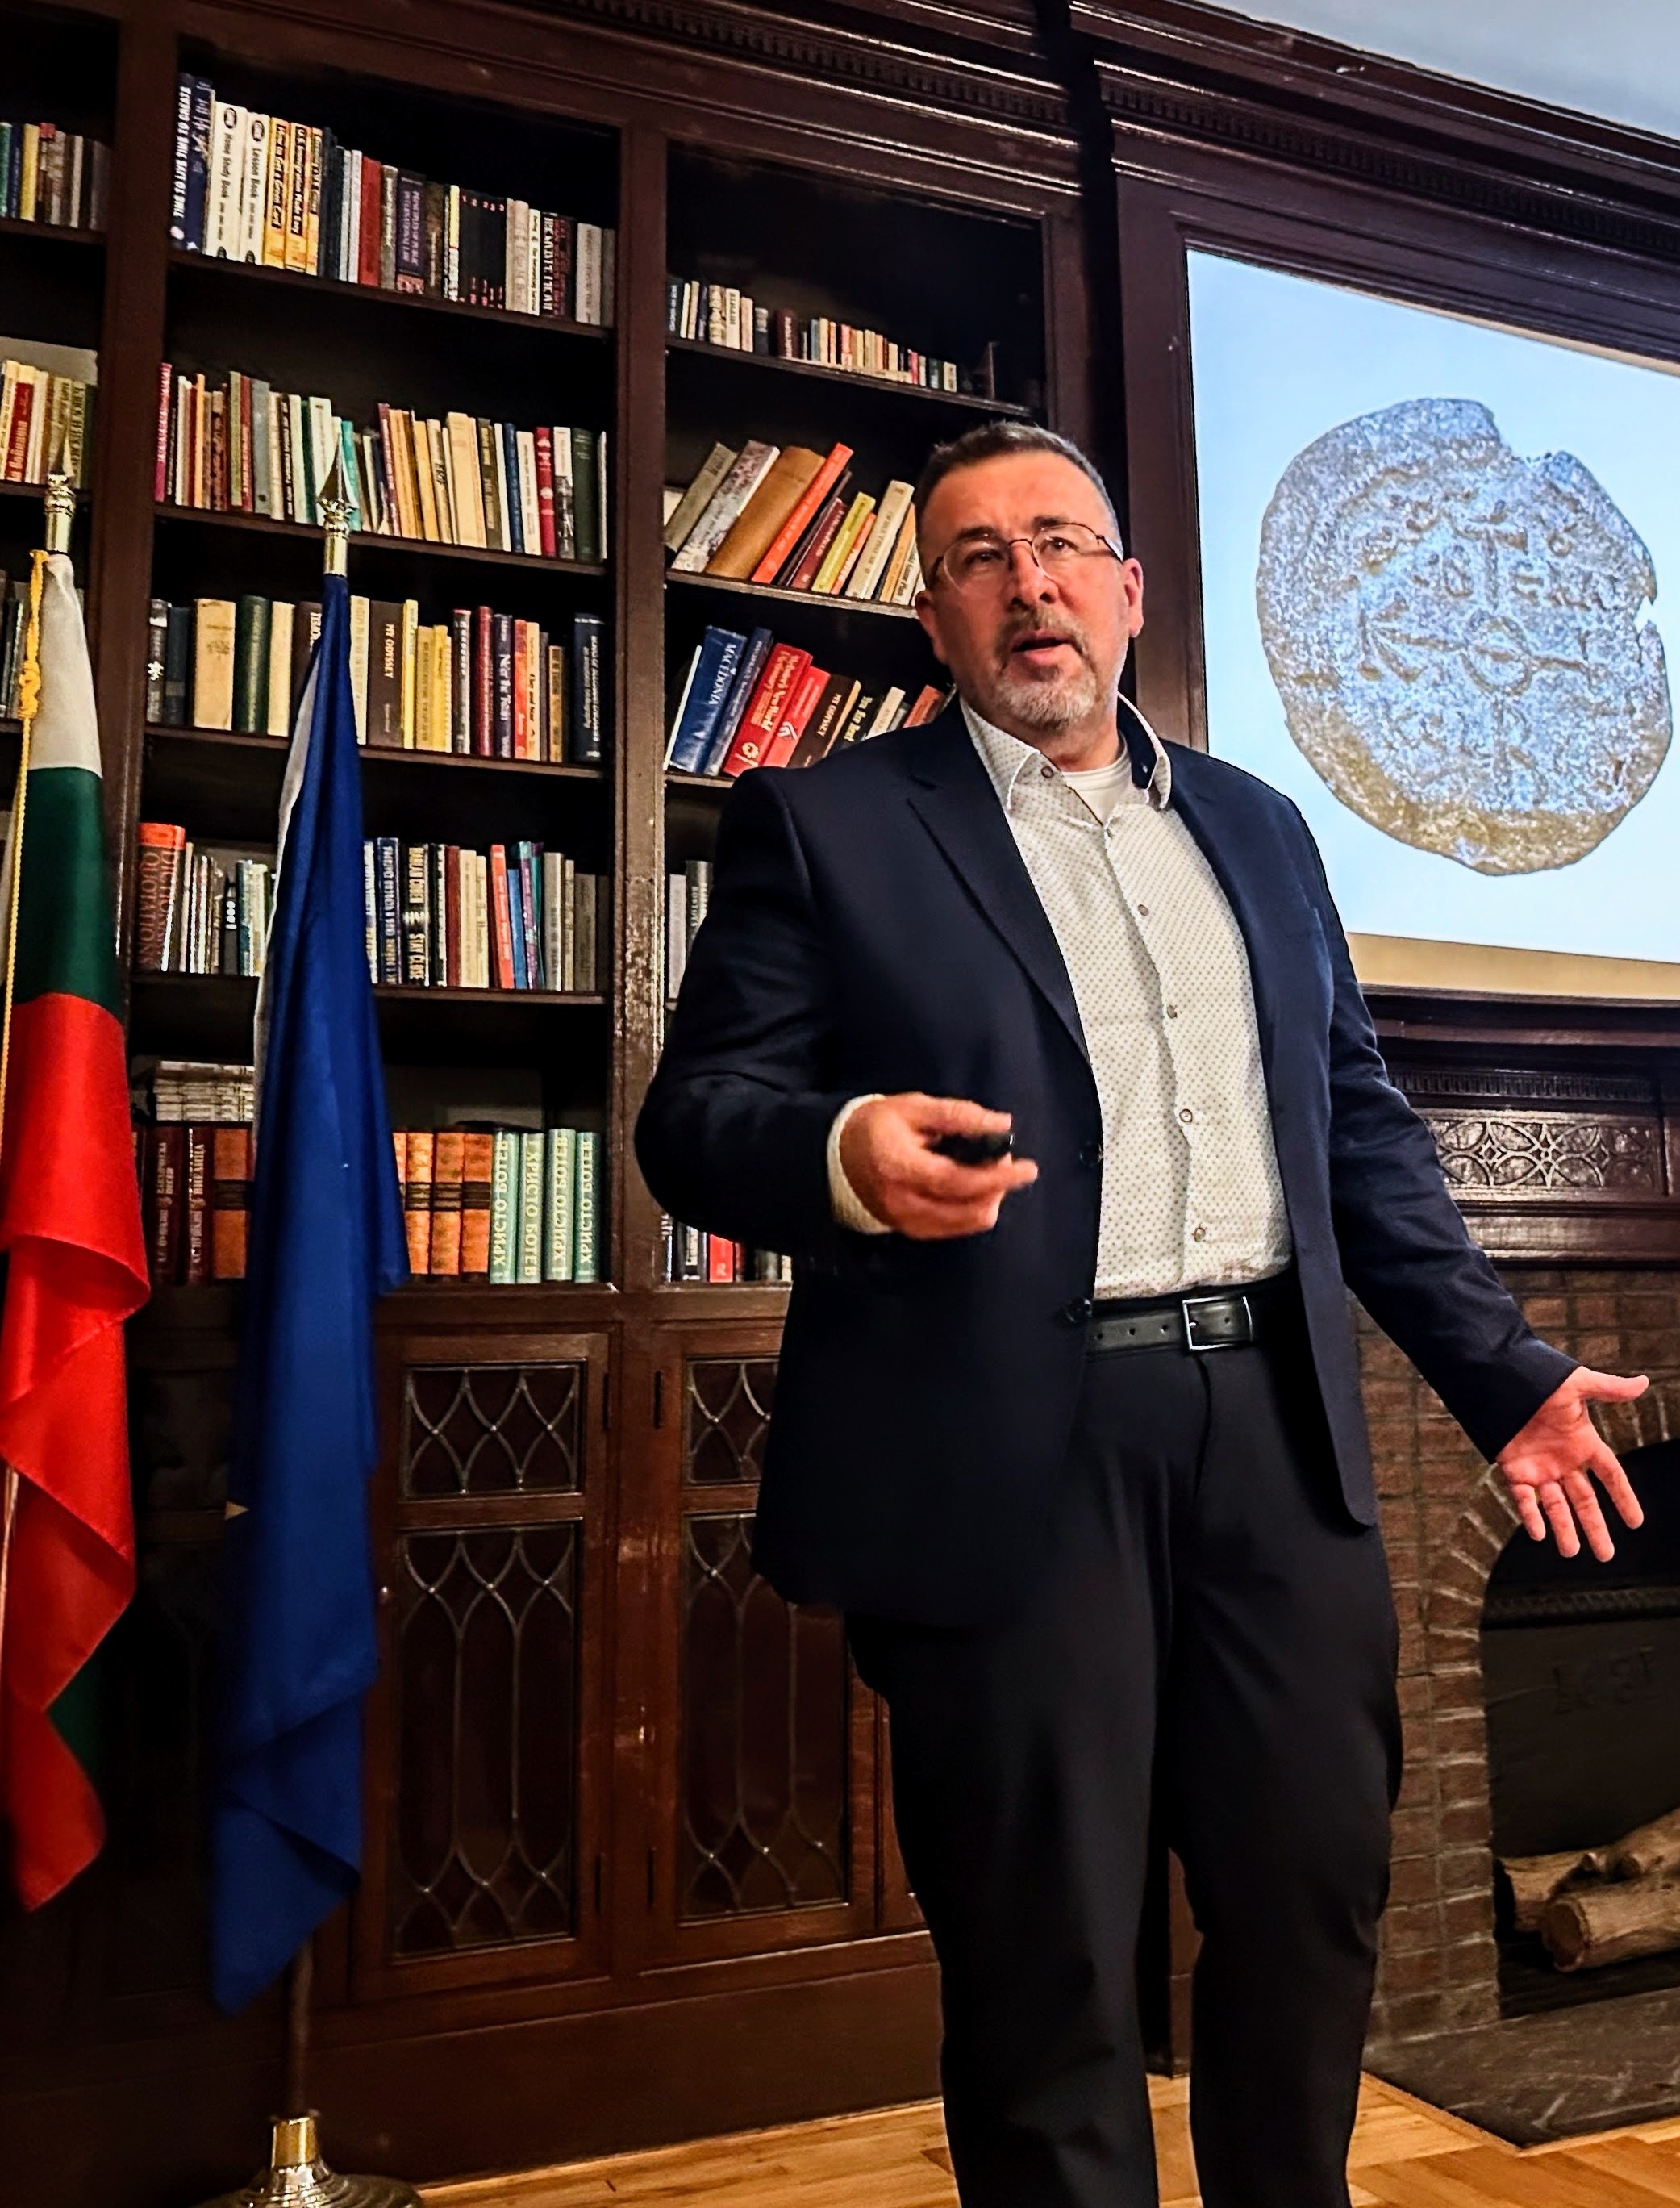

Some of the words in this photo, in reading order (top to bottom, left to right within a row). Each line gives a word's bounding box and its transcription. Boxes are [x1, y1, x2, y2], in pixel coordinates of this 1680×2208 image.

[178, 86, 191, 120] CREATE
[177, 122, 189, 136] TO
[276, 127, 285, 146] How
[176, 137, 188, 159] TIME
[223, 133, 233, 155] Home
[175, 160, 187, 181] LIVE
[220, 157, 232, 178] Study
[252, 148, 262, 176] Lesson
[274, 157, 284, 172] Get
[294, 145, 304, 192] Immigration
[174, 182, 186, 194] TO
[221, 180, 231, 198] Book
[250, 178, 261, 198] Book
[273, 180, 283, 204] Green
[173, 194, 185, 218] TIME
[272, 206, 282, 228] Card
[294, 194, 302, 215] Made
[385, 624, 395, 637] MY
[385, 638, 395, 679] ODYSSEY
[708, 643, 736, 705] MACEDONIA
[409, 848, 424, 878] HARLAN
[409, 879, 424, 904] COBEN
[140, 851, 160, 964] QUOTATIONS
[409, 933, 425, 954] STAY
[409, 954, 425, 979] CLOSE
[495, 1140, 508, 1193] БОТЕВ
[555, 1136, 568, 1190] БОТЕВ
[581, 1140, 593, 1192] БОТЕВ
[525, 1152, 539, 1217] ХРИСТО
[493, 1199, 507, 1266] ХРИСТО
[553, 1195, 566, 1260] ХРИСТО
[580, 1199, 593, 1264] ХРИСТО
[525, 1224, 538, 1277] БОТЕВ
